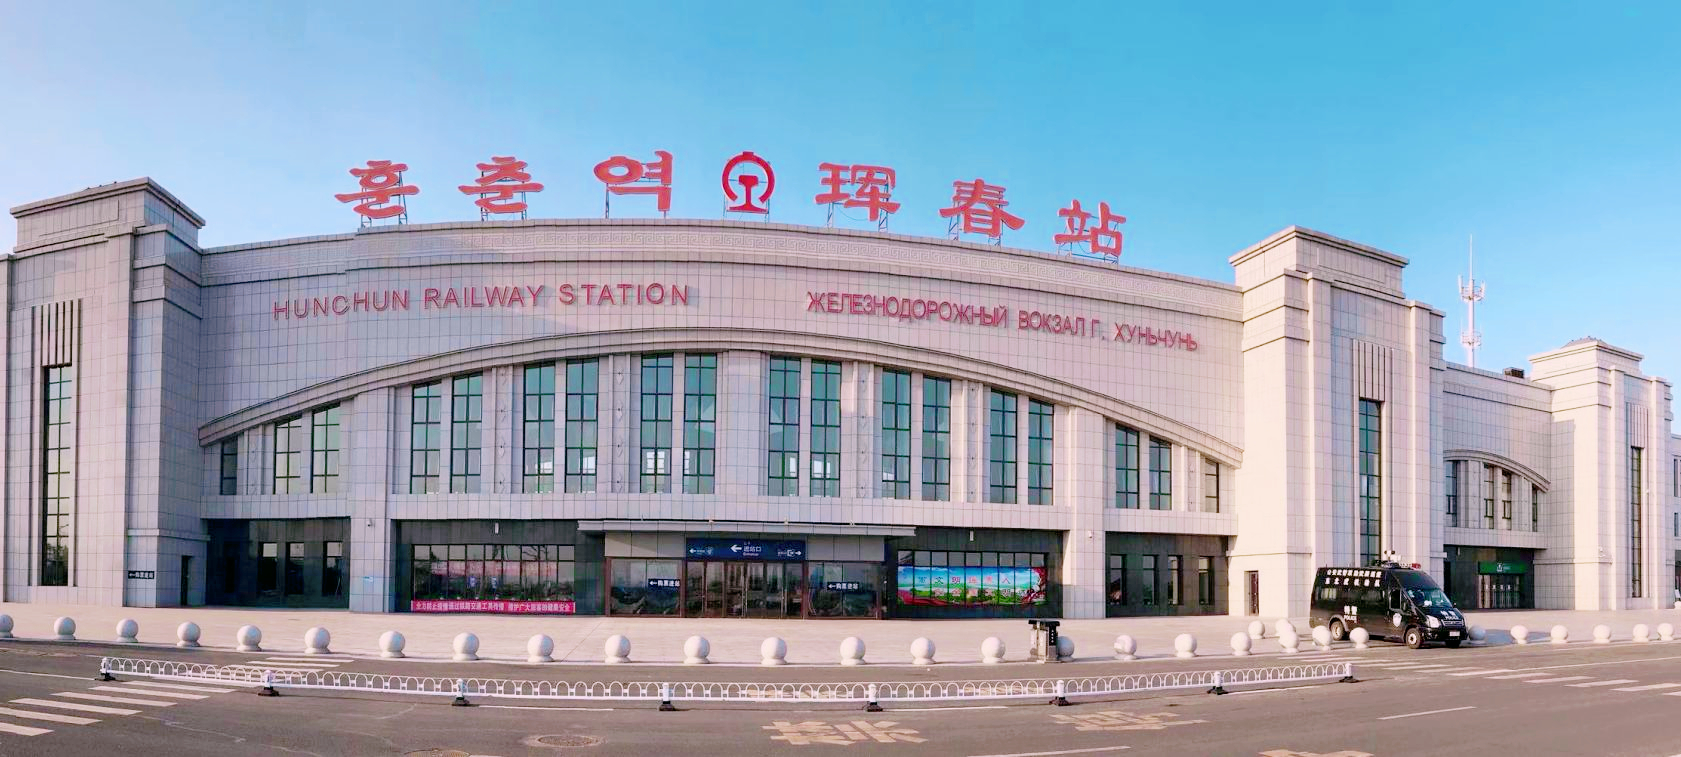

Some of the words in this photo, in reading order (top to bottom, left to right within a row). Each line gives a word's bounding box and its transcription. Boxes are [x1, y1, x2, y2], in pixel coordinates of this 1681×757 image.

[334, 150, 673, 219] 훈춘역
[814, 162, 1127, 257] 珲春站
[272, 289, 409, 321] HUNCHUN
[424, 284, 544, 310] RAILWAY
[559, 281, 690, 306] STATION
[807, 291, 1009, 328] ЖЕЛЕЗНОДОРОЖНЫЙ
[1018, 310, 1086, 336] ВОКЗАЛ
[1114, 323, 1198, 352] ХУНЬЧУНЬ
